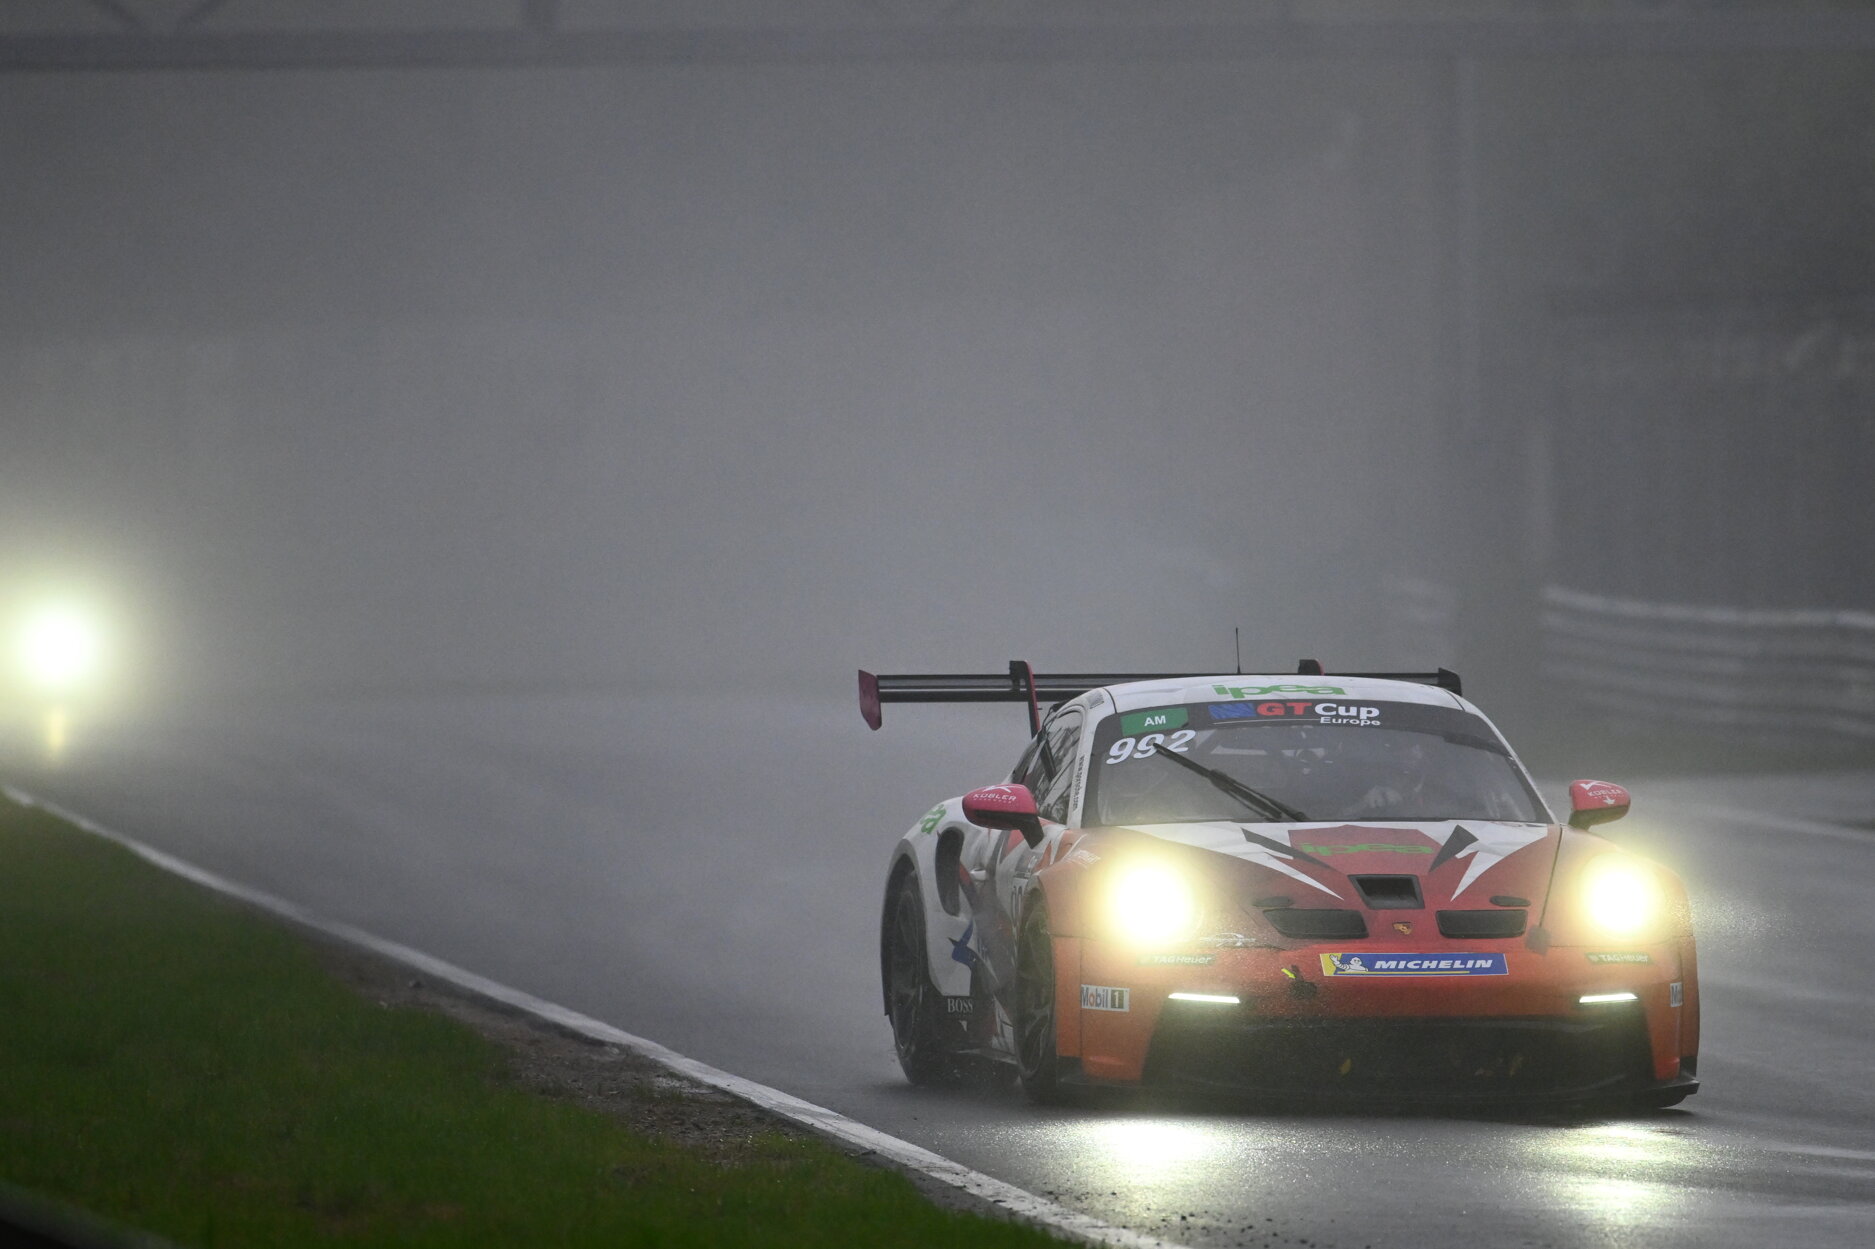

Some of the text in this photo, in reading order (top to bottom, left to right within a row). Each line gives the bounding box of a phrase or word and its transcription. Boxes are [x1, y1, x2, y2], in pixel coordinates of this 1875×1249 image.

[1211, 684, 1347, 699] ipea
[1257, 702, 1380, 720] GT Cup
[1144, 715, 1167, 727] AM
[1319, 716, 1381, 727] Europe
[1105, 729, 1197, 765] 992
[1374, 958, 1494, 970] MICHELIN
[1081, 985, 1123, 1008] Mobil 1
[947, 998, 974, 1014] BOSS
